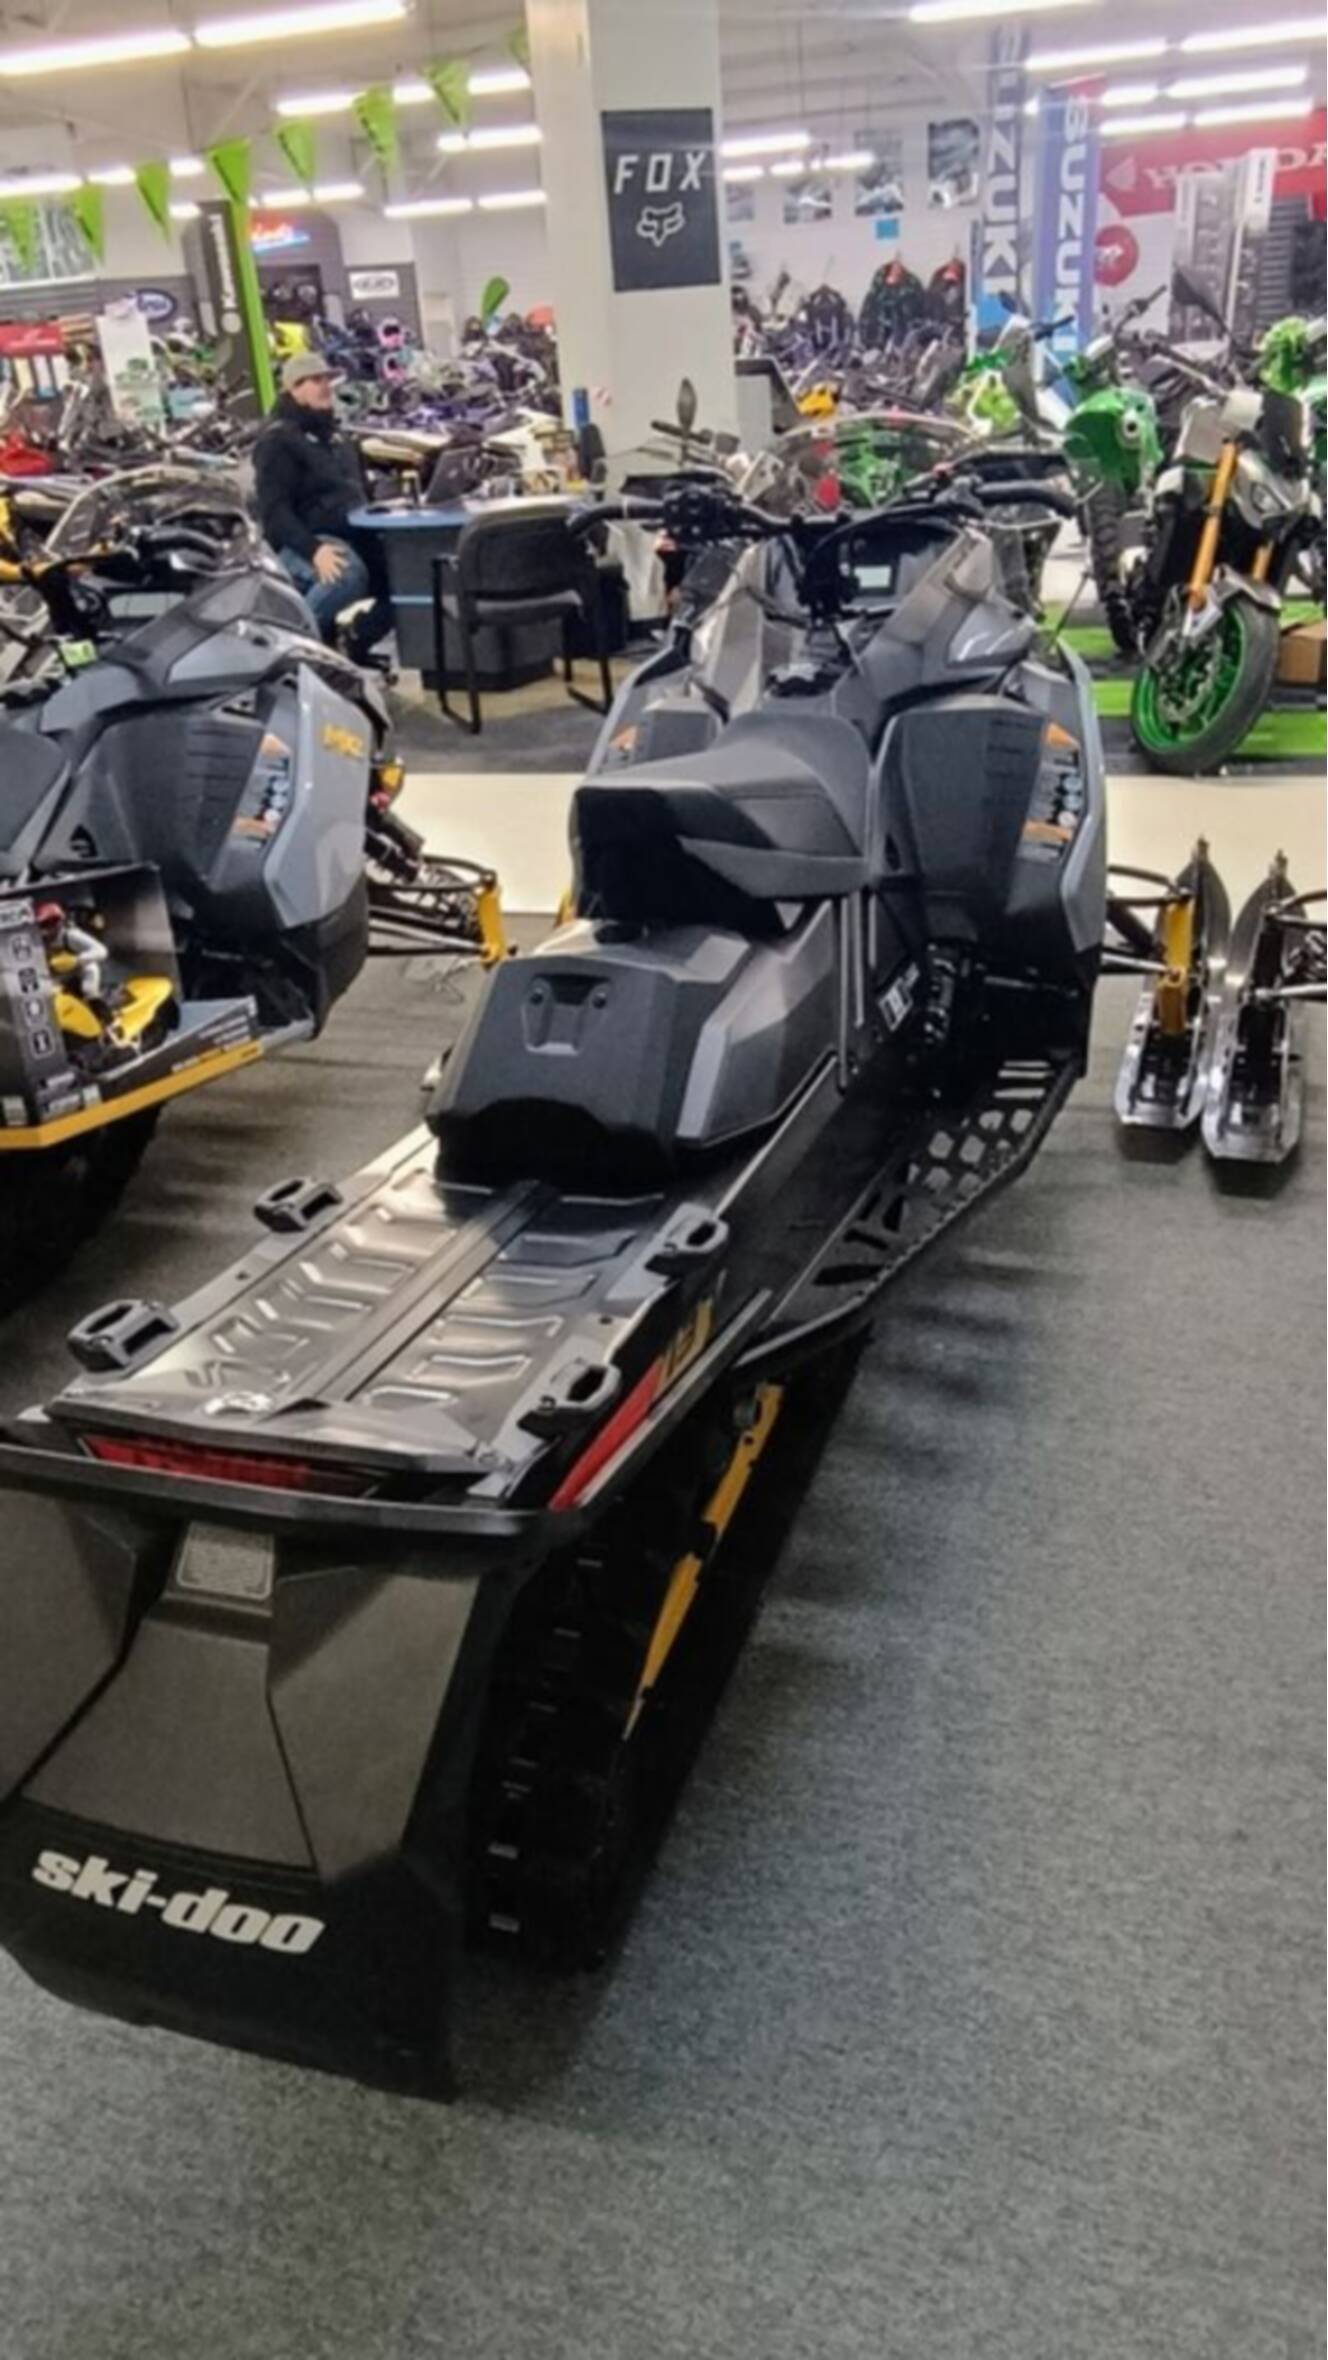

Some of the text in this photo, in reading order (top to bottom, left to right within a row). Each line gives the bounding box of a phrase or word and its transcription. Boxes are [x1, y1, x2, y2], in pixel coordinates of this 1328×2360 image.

[614, 151, 706, 194] FOX
[982, 29, 1022, 295] SUZUKI
[1143, 141, 1327, 190] HODA
[1053, 95, 1089, 350] SUZUKI
[32, 1850, 326, 1955] ski-doo
